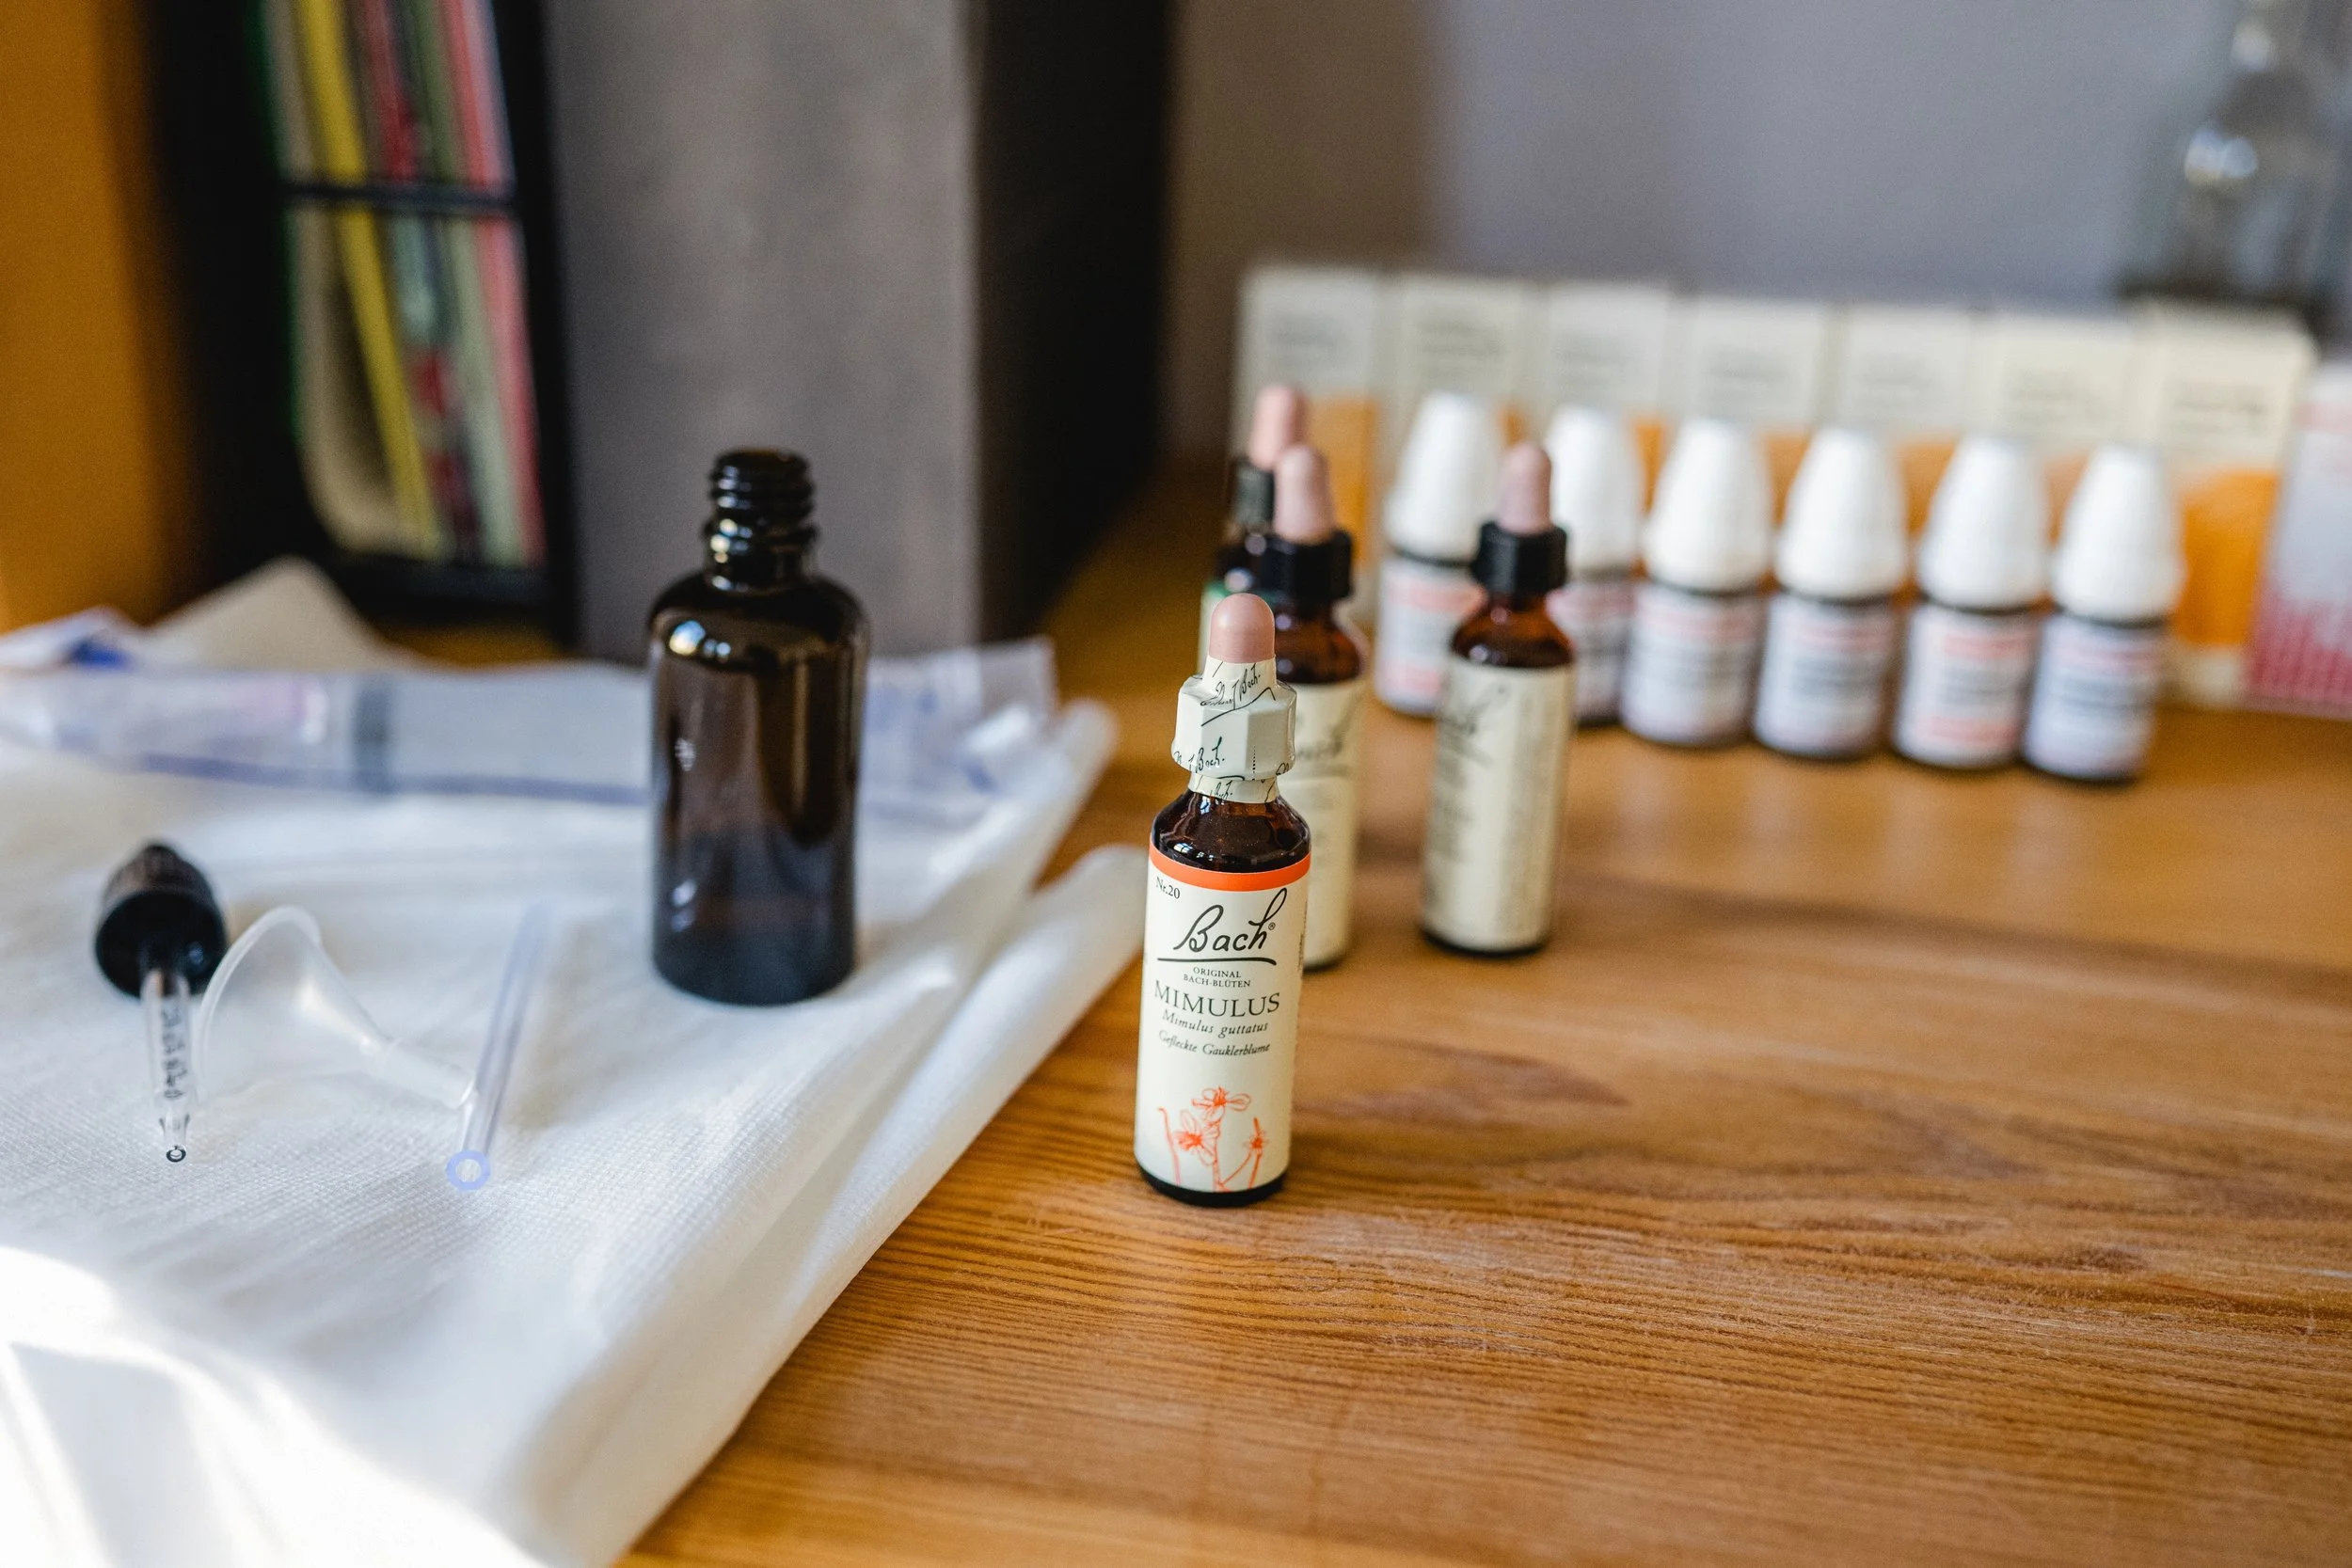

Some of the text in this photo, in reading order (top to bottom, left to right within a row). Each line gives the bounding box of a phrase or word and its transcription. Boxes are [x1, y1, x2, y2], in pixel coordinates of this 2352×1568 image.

[1155, 877, 1181, 899] Nr.20
[1183, 974, 1251, 988] BACH-BLÜTEN
[1193, 966, 1242, 978] ORIGINAL
[1154, 979, 1280, 1018] MIMULUS
[1162, 1009, 1269, 1038] Mimulus guttatus
[1158, 1029, 1271, 1057] Gefleckte Gauklerblume
